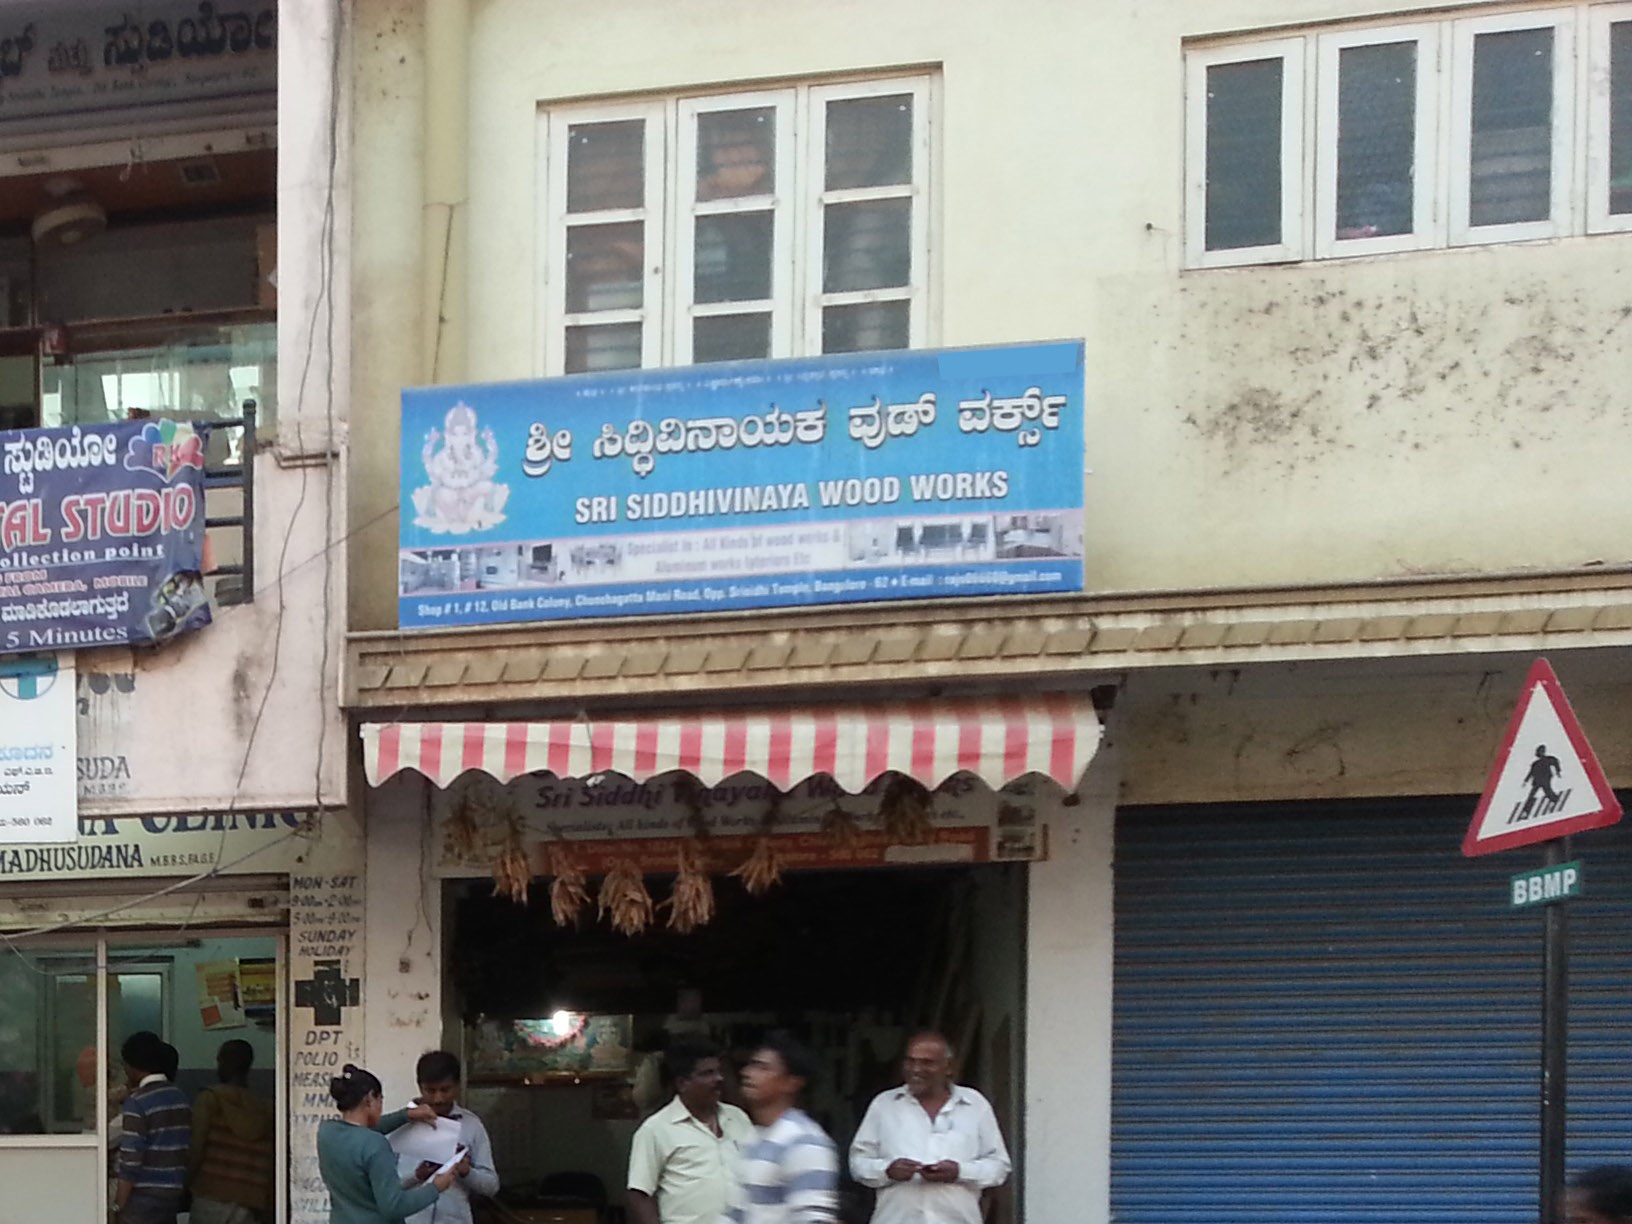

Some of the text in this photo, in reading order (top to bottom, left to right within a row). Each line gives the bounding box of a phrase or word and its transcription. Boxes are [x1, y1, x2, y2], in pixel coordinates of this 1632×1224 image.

[4, 424, 116, 494] ಸ್ಟುಡಿಯೋ
[522, 422, 571, 477] ಶ್ರೀ
[575, 471, 1009, 524] SRI SIDDHIVINAYA WOOD WORKS
[60, 483, 195, 543] STUDIO
[105, 543, 165, 566] point
[5, 570, 48, 585] FROM
[93, 575, 148, 590] MOBILE
[418, 603, 442, 618] Shop
[510, 596, 535, 611] Bank
[6, 631, 19, 647] 5
[28, 625, 128, 646] Minutes
[293, 876, 357, 889] MON-SAT
[1513, 868, 1576, 904] BBMP
[299, 930, 356, 942] SUNDAY
[299, 945, 353, 957] HOLIDAY
[305, 1031, 343, 1046] DPT
[295, 1052, 338, 1066] POLIO
